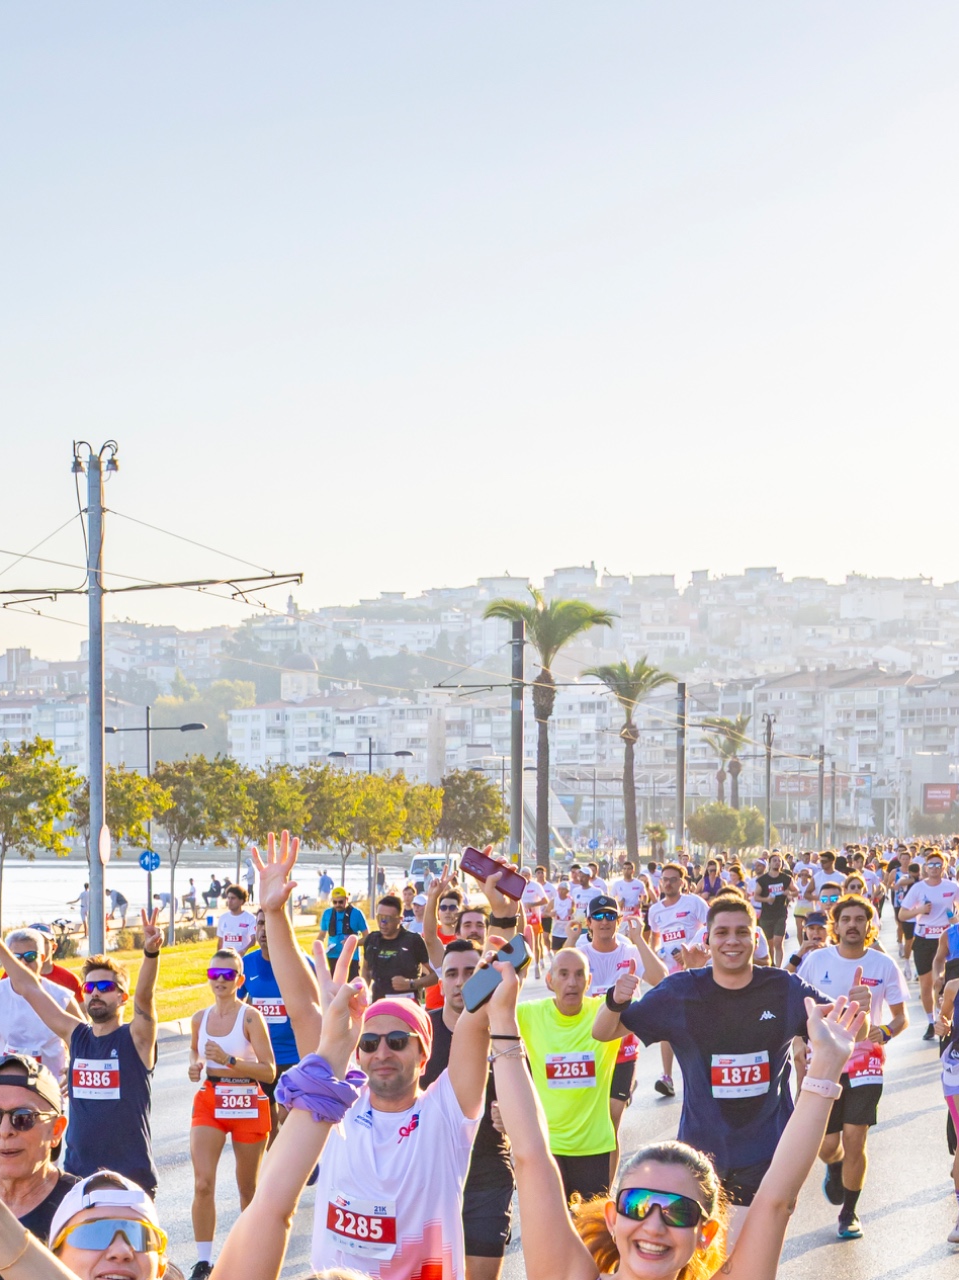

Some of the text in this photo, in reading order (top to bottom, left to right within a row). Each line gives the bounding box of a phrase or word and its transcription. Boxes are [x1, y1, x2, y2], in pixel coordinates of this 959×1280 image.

[257, 1005, 281, 1015] 2921
[553, 1062, 588, 1078] 2261
[721, 1065, 762, 1084] 1873
[78, 1070, 111, 1087] 3386
[221, 1095, 252, 1108] 3043
[334, 1208, 383, 1240] 2285
